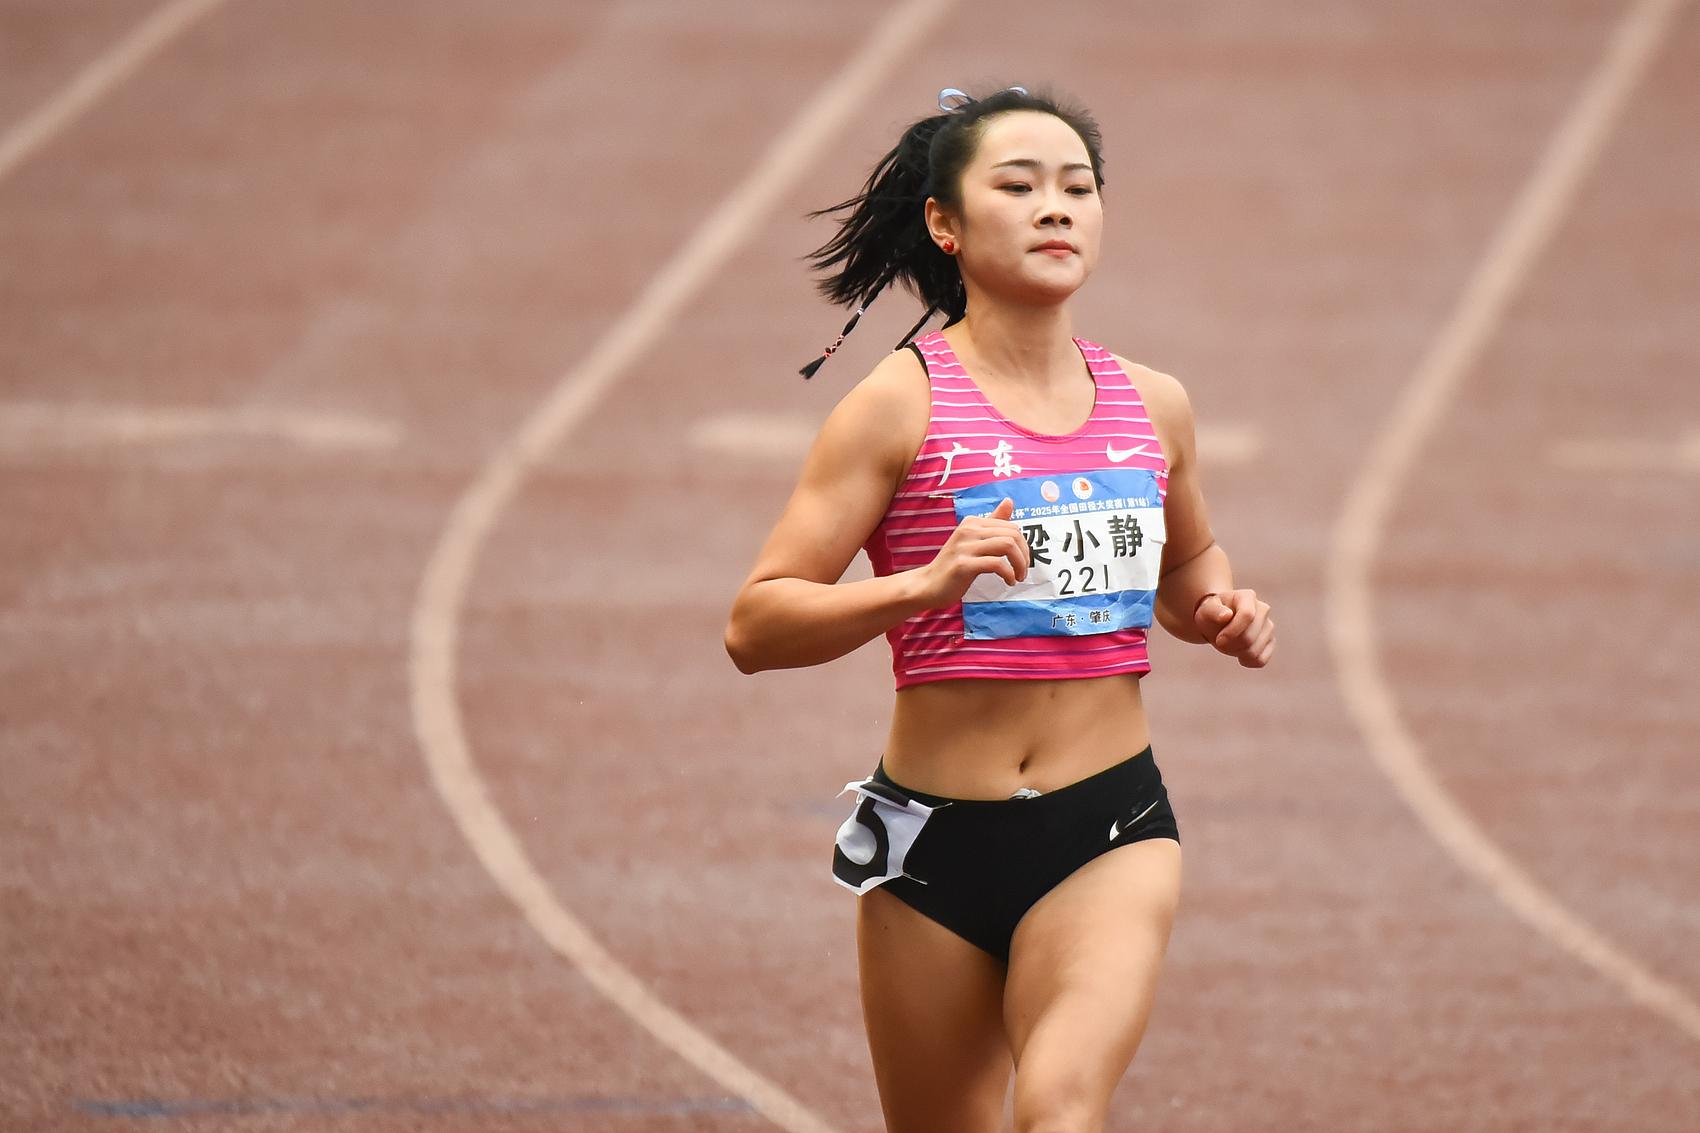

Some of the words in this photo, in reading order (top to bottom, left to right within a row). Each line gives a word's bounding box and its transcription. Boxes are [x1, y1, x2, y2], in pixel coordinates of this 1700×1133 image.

[938, 440, 1022, 486] 广东
[1019, 514, 1143, 568] 梁小静
[1057, 564, 1109, 595] 221
